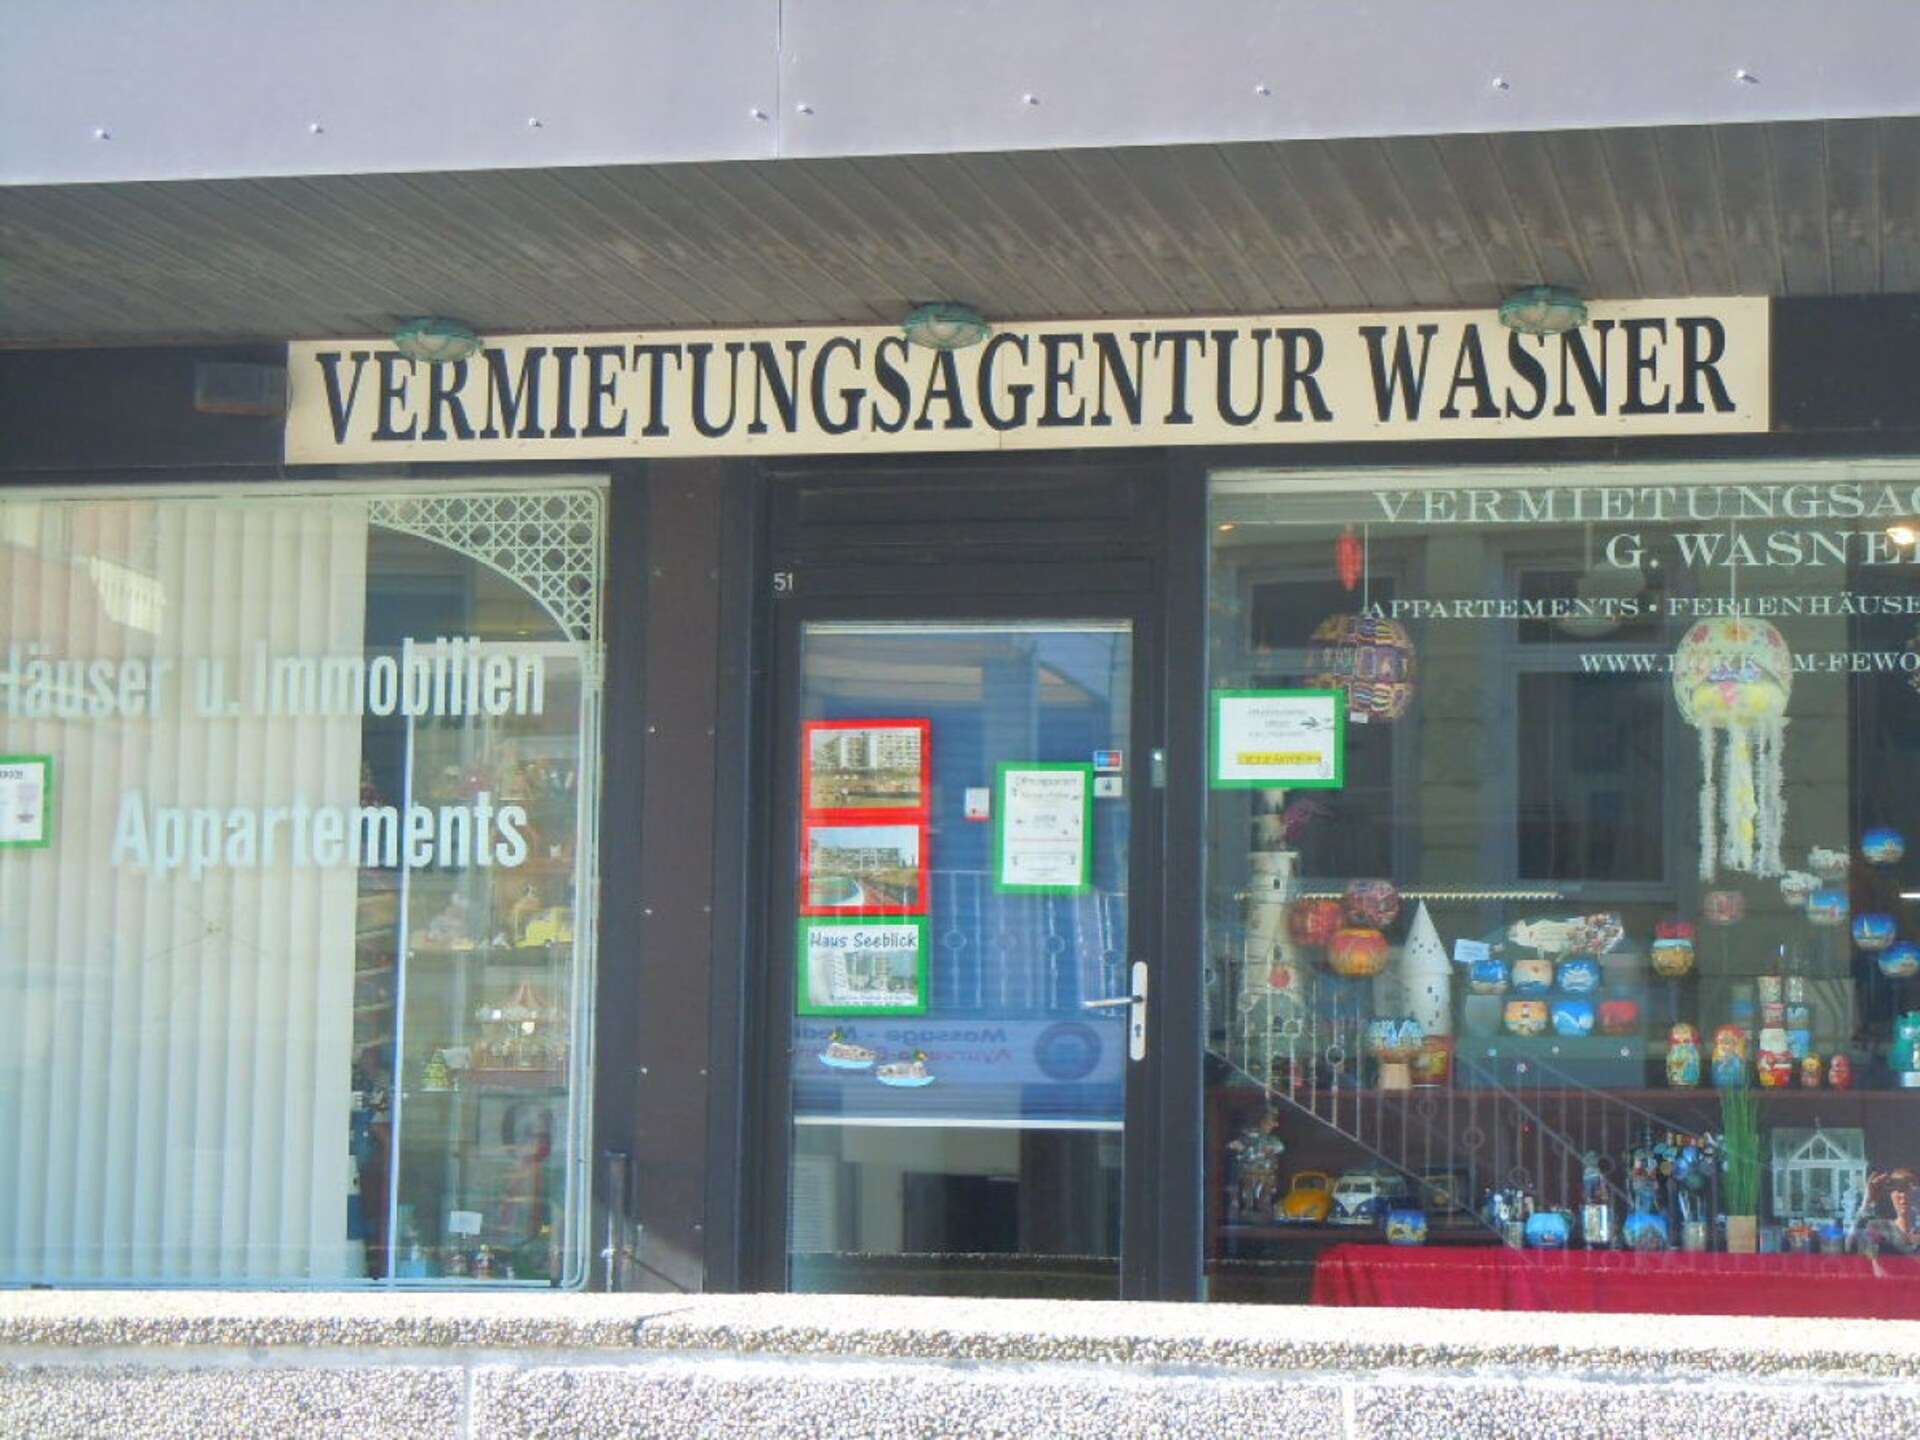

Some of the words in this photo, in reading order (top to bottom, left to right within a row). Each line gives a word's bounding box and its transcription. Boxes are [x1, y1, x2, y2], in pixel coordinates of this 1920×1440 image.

[315, 327, 1334, 445] VERMIETUNGSAGENTUR
[1358, 314, 1737, 424] WASNER
[1606, 532, 1660, 569] G.
[1671, 529, 1920, 569] WASNE
[773, 572, 793, 591] 51
[1367, 597, 1641, 619] APPARTEMENTS
[196, 657, 240, 717] u.
[254, 636, 546, 717] Immobilien
[110, 789, 528, 882] Appartements
[809, 931, 848, 948] Haus
[853, 931, 917, 948] Seeblick
